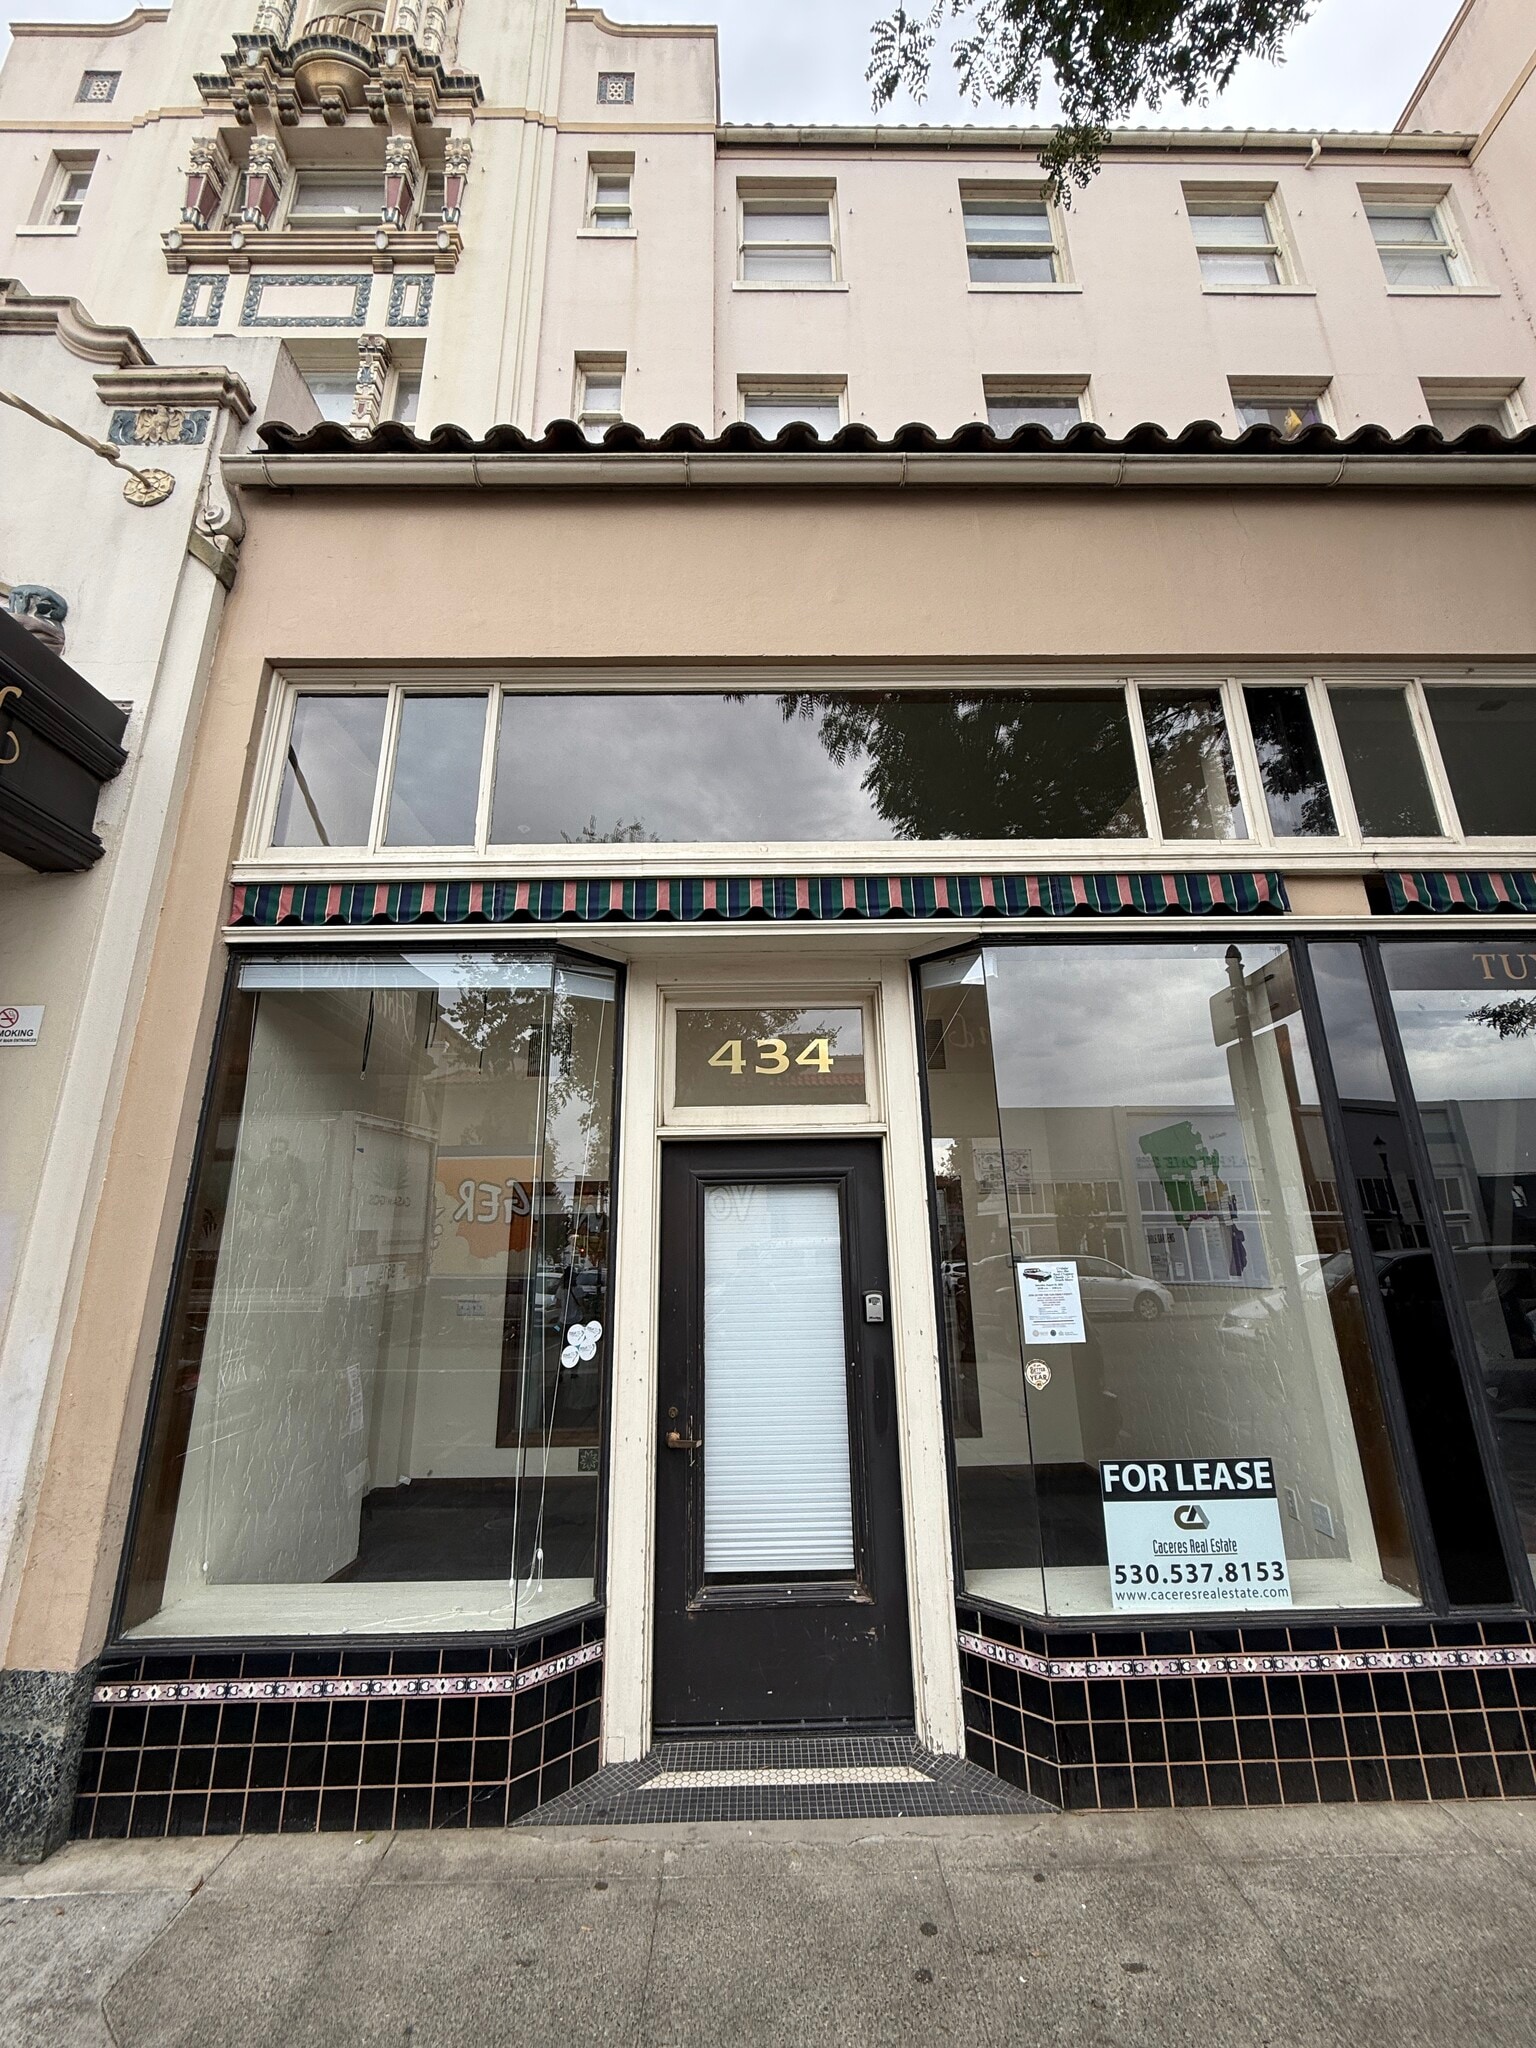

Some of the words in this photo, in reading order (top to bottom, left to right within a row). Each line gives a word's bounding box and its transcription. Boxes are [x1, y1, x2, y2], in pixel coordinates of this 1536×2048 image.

[1472, 953, 1536, 980] TU
[707, 1038, 834, 1075] 434
[1103, 1464, 1168, 1492] FOR
[1175, 1461, 1272, 1491] LEASE
[1152, 1539, 1188, 1554] Caceres
[1190, 1539, 1208, 1553] Real
[1210, 1537, 1238, 1553] Estate
[1115, 1561, 1285, 1584] 530.537.8153
[1115, 1587, 1289, 1601] www.caceresrealestate.com
